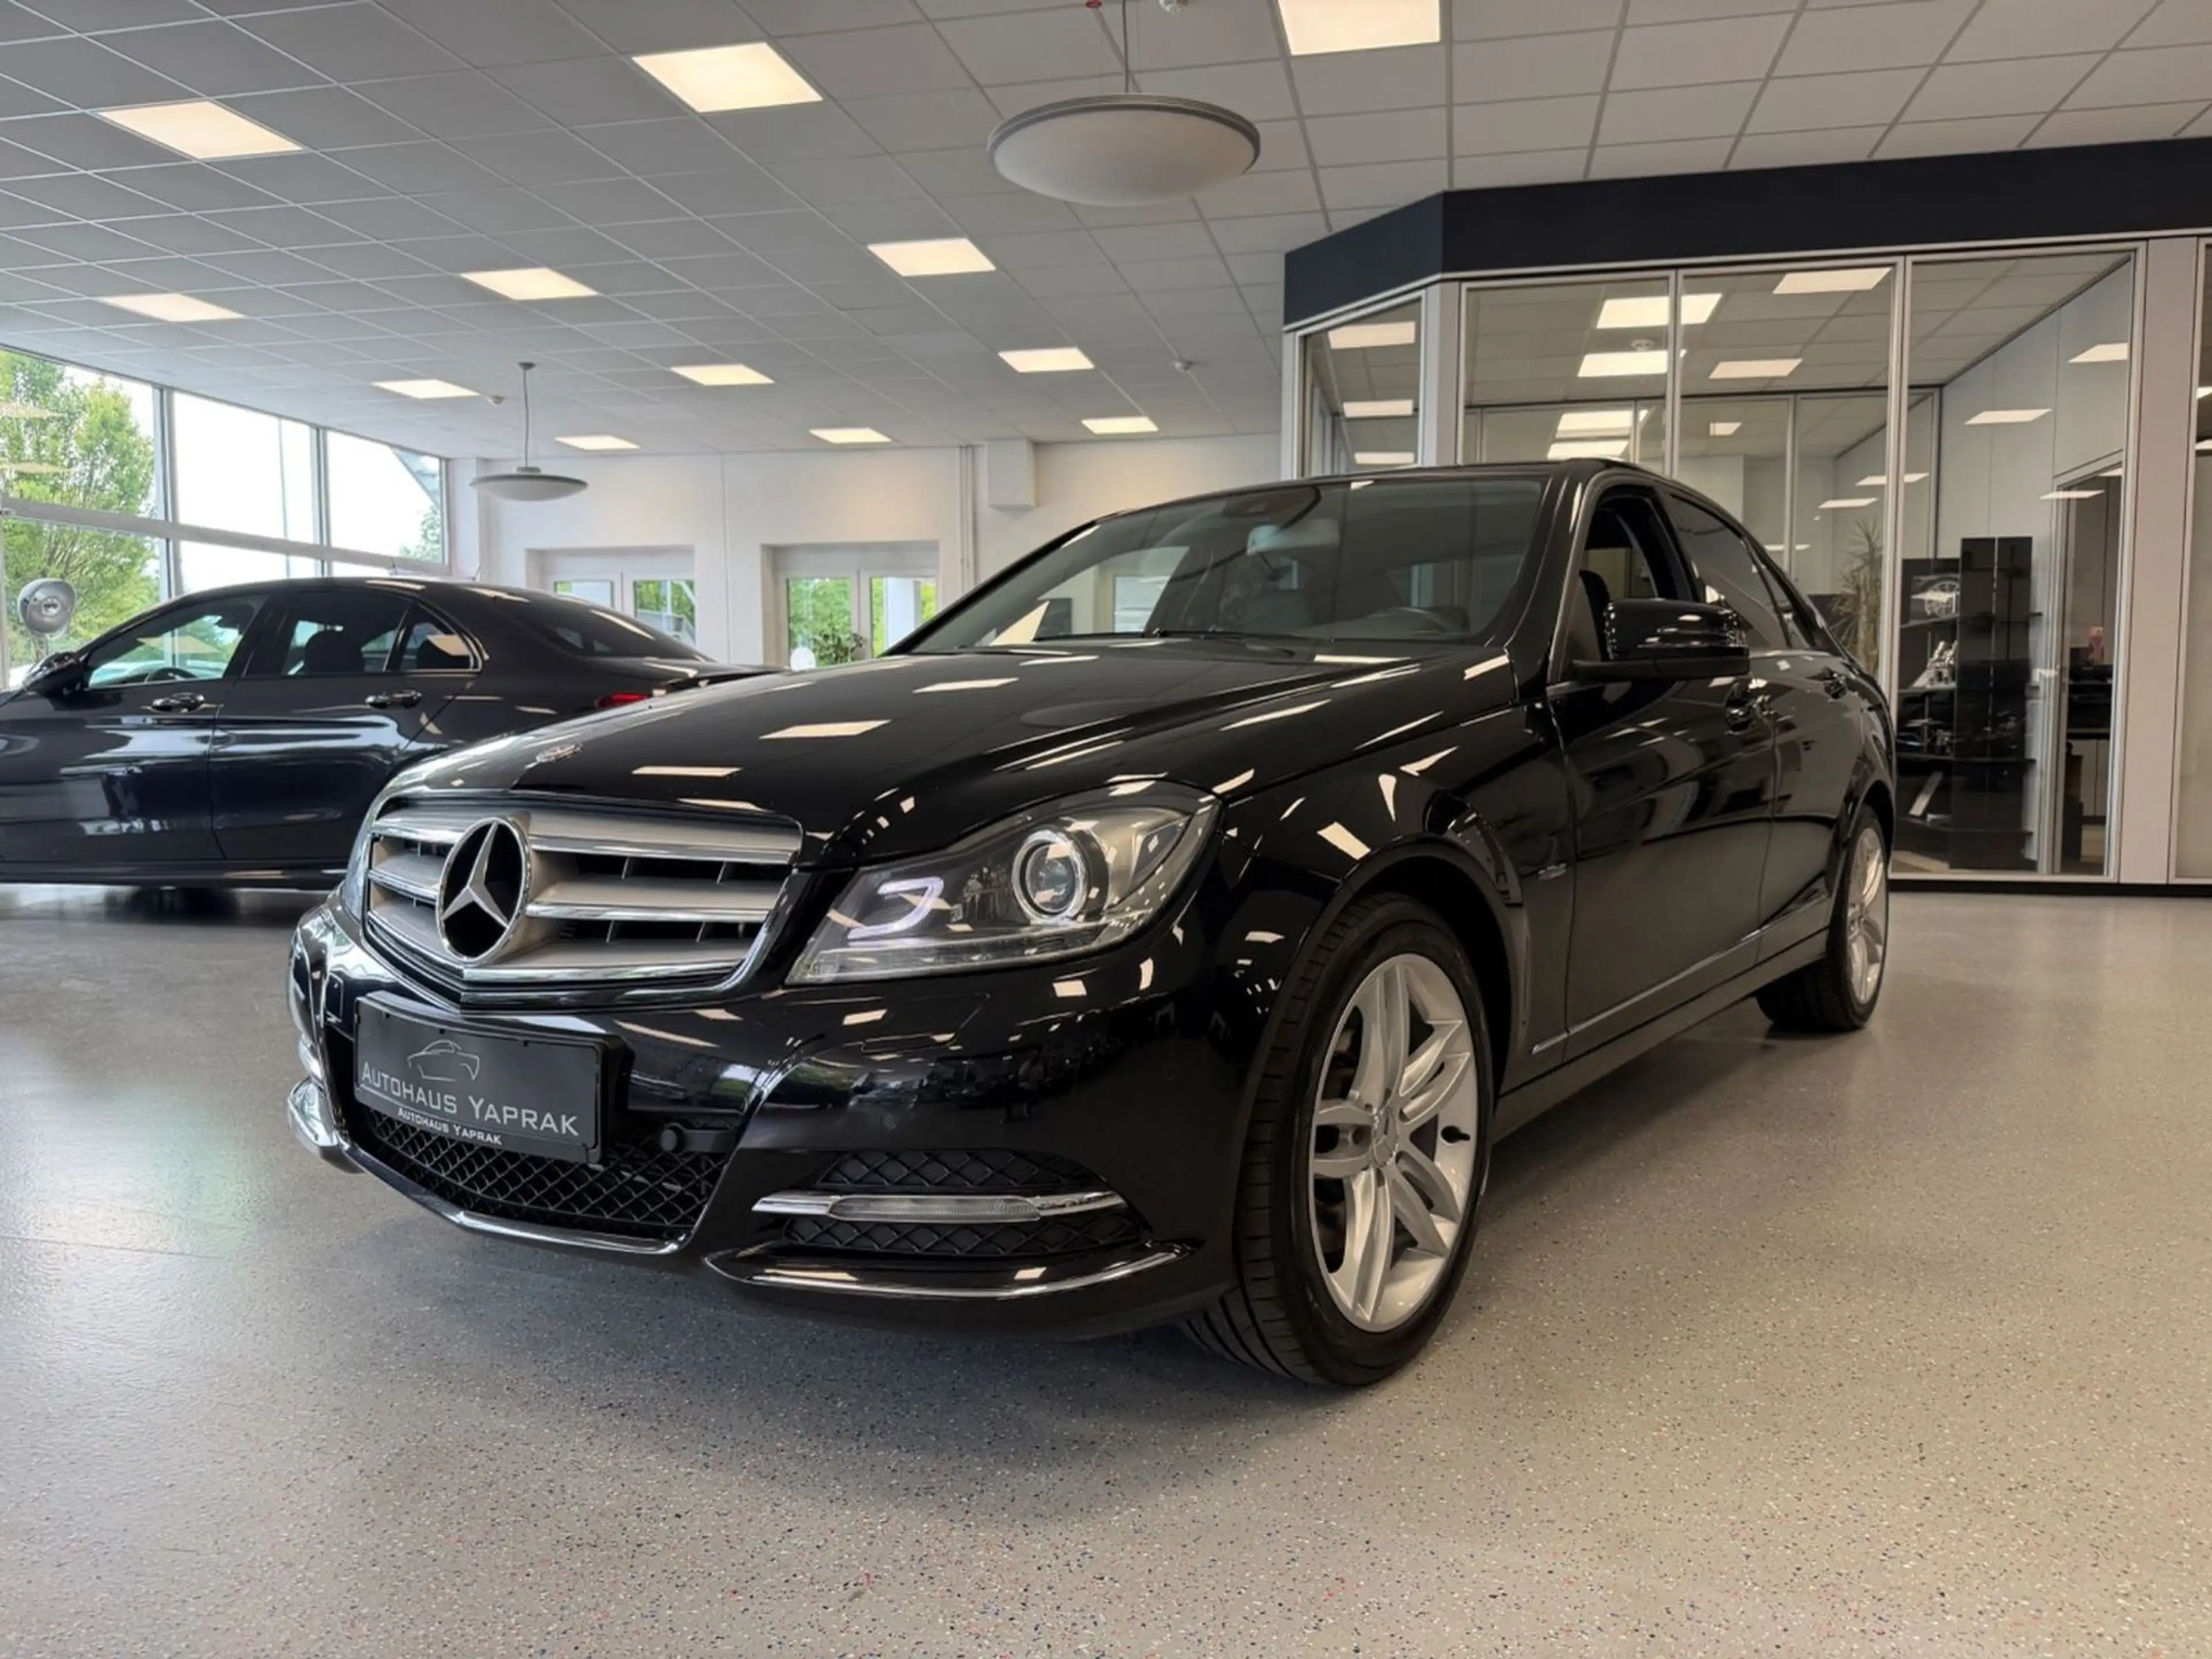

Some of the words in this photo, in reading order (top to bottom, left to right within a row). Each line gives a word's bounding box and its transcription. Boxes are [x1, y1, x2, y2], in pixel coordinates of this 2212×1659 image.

[362, 1061, 457, 1114] AUTOHAUS
[468, 1096, 579, 1136] YAPRAK
[397, 1109, 449, 1134] AUTOHAUS
[453, 1124, 502, 1145] YAPRAK
